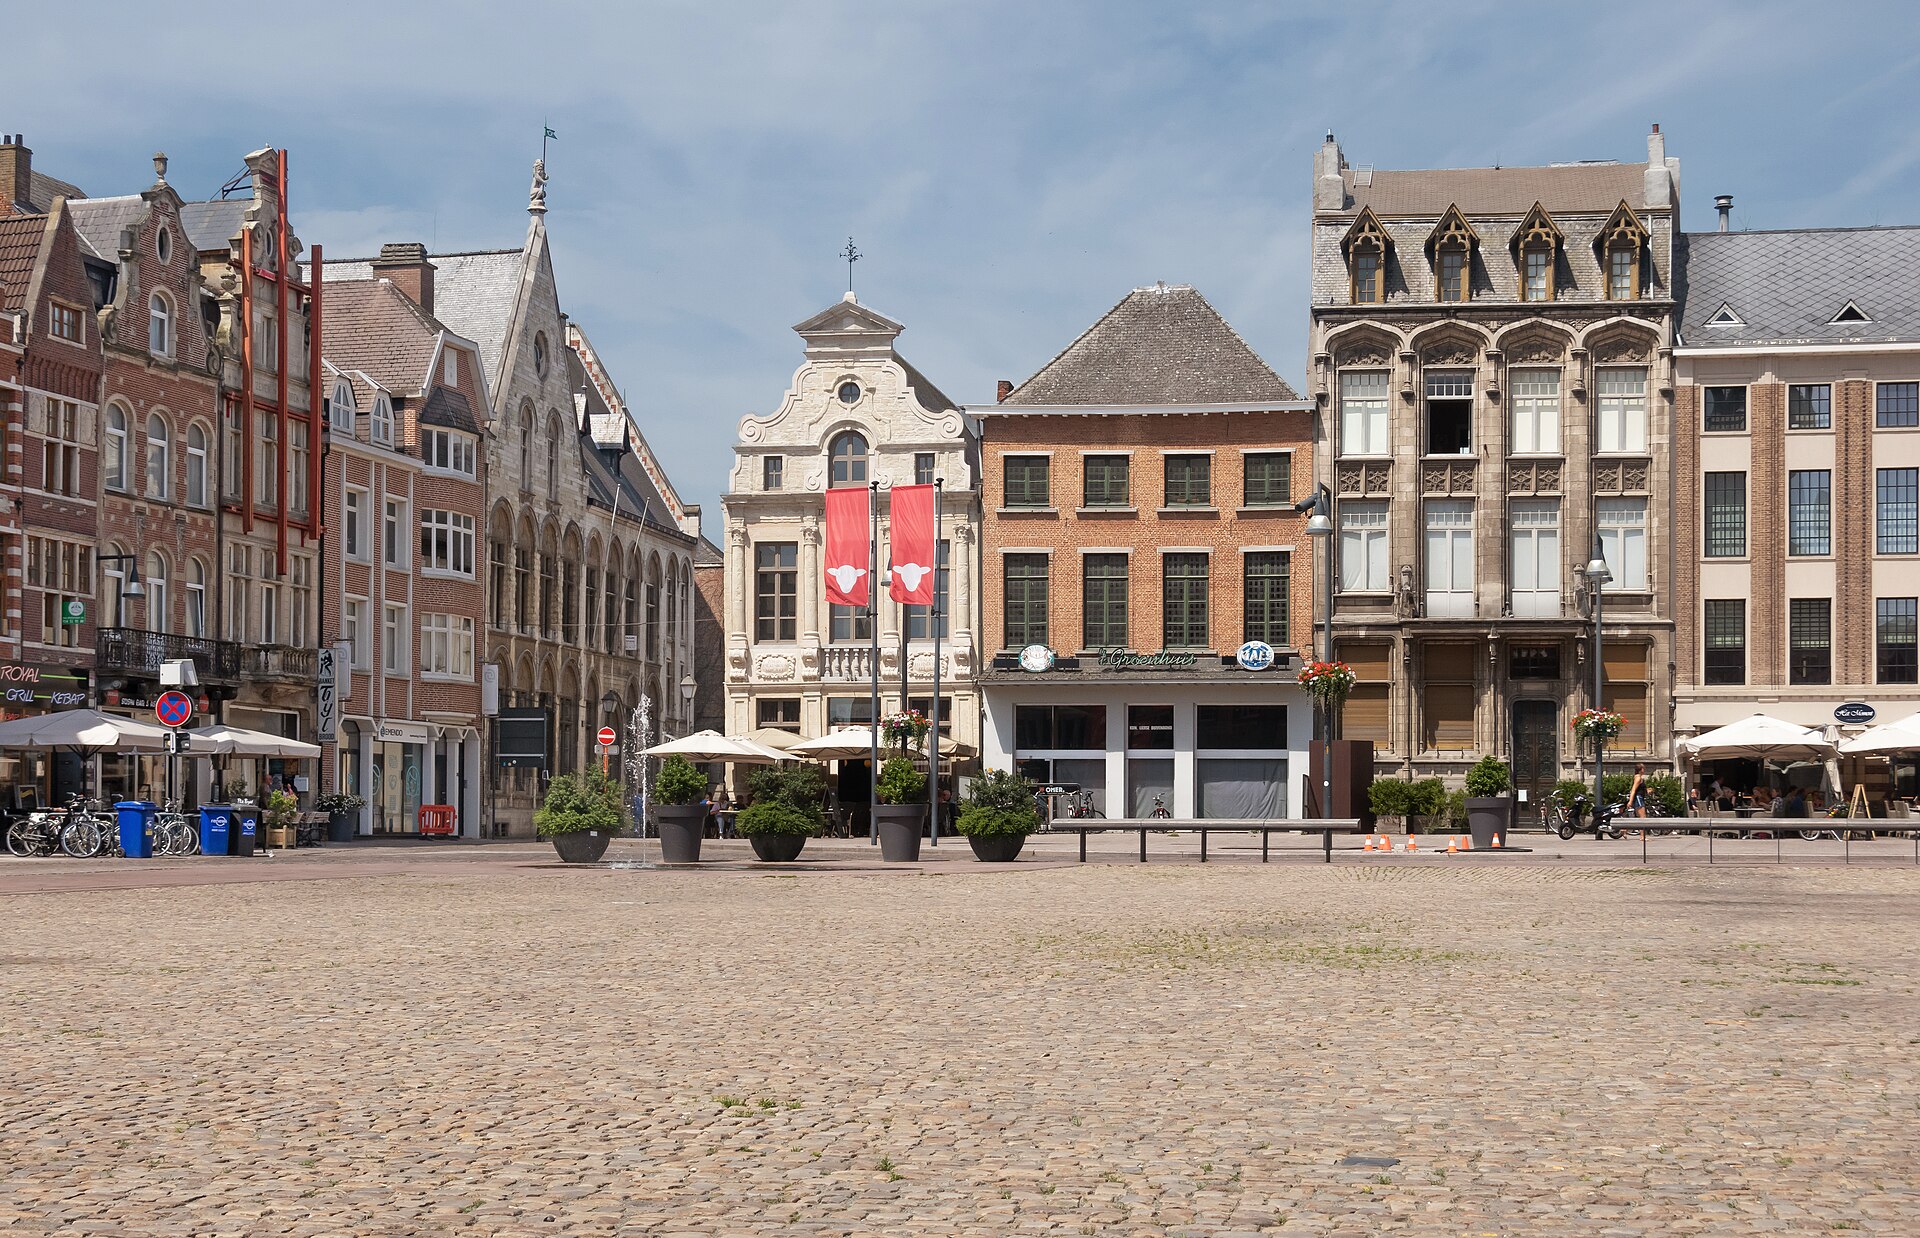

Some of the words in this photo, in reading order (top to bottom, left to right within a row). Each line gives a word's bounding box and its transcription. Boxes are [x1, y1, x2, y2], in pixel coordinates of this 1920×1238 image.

[1110, 647, 1195, 668] Groenhuis
[1, 666, 39, 682] ROYAL
[6, 688, 34, 702] GRILL
[50, 691, 86, 704] KEBAP
